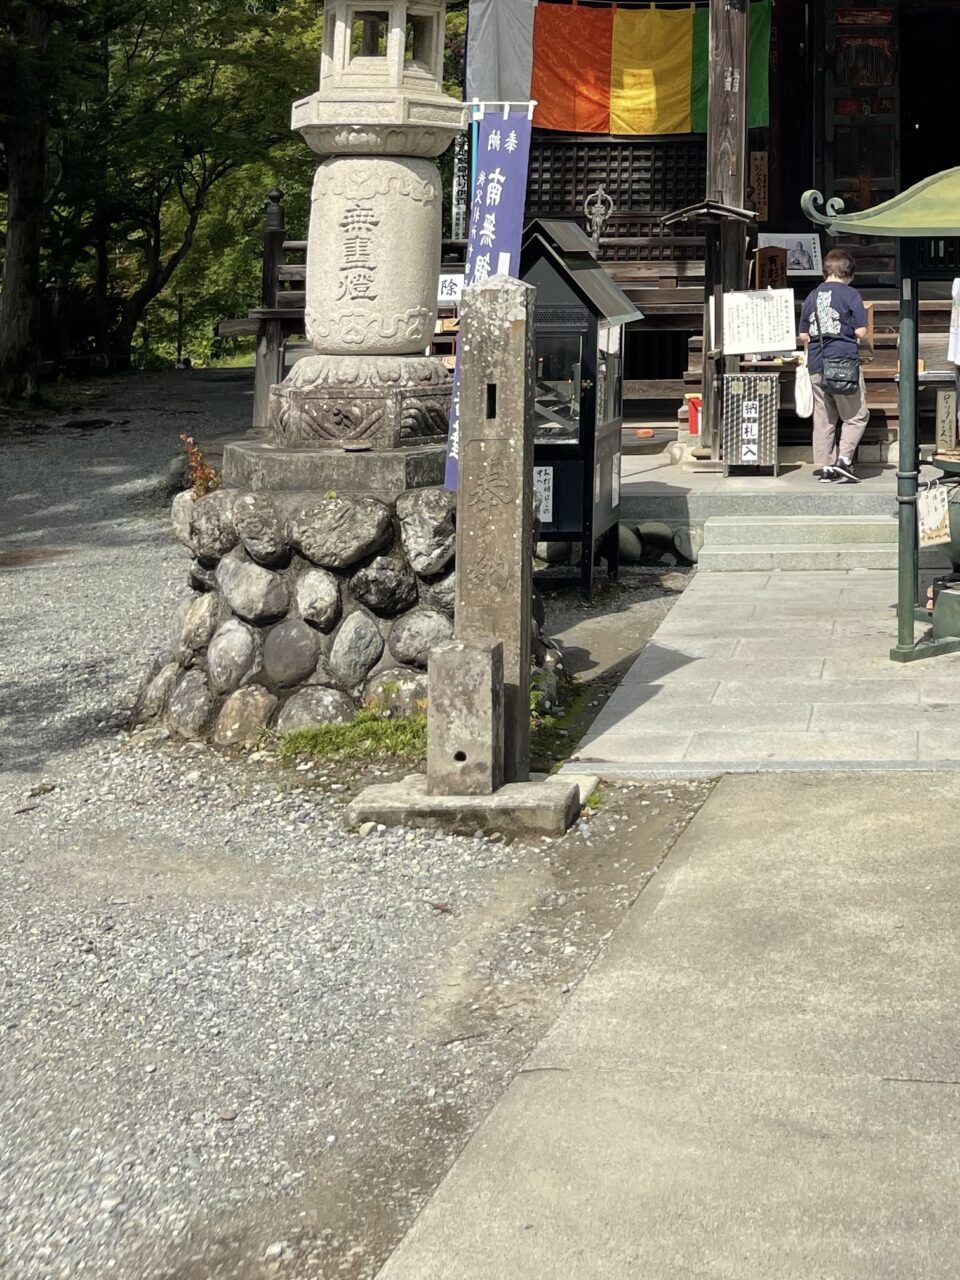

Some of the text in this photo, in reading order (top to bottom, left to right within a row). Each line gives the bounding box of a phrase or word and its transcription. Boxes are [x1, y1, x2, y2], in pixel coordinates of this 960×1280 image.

[440, 278, 458, 297] 除
[744, 402, 758, 457] 納札入
